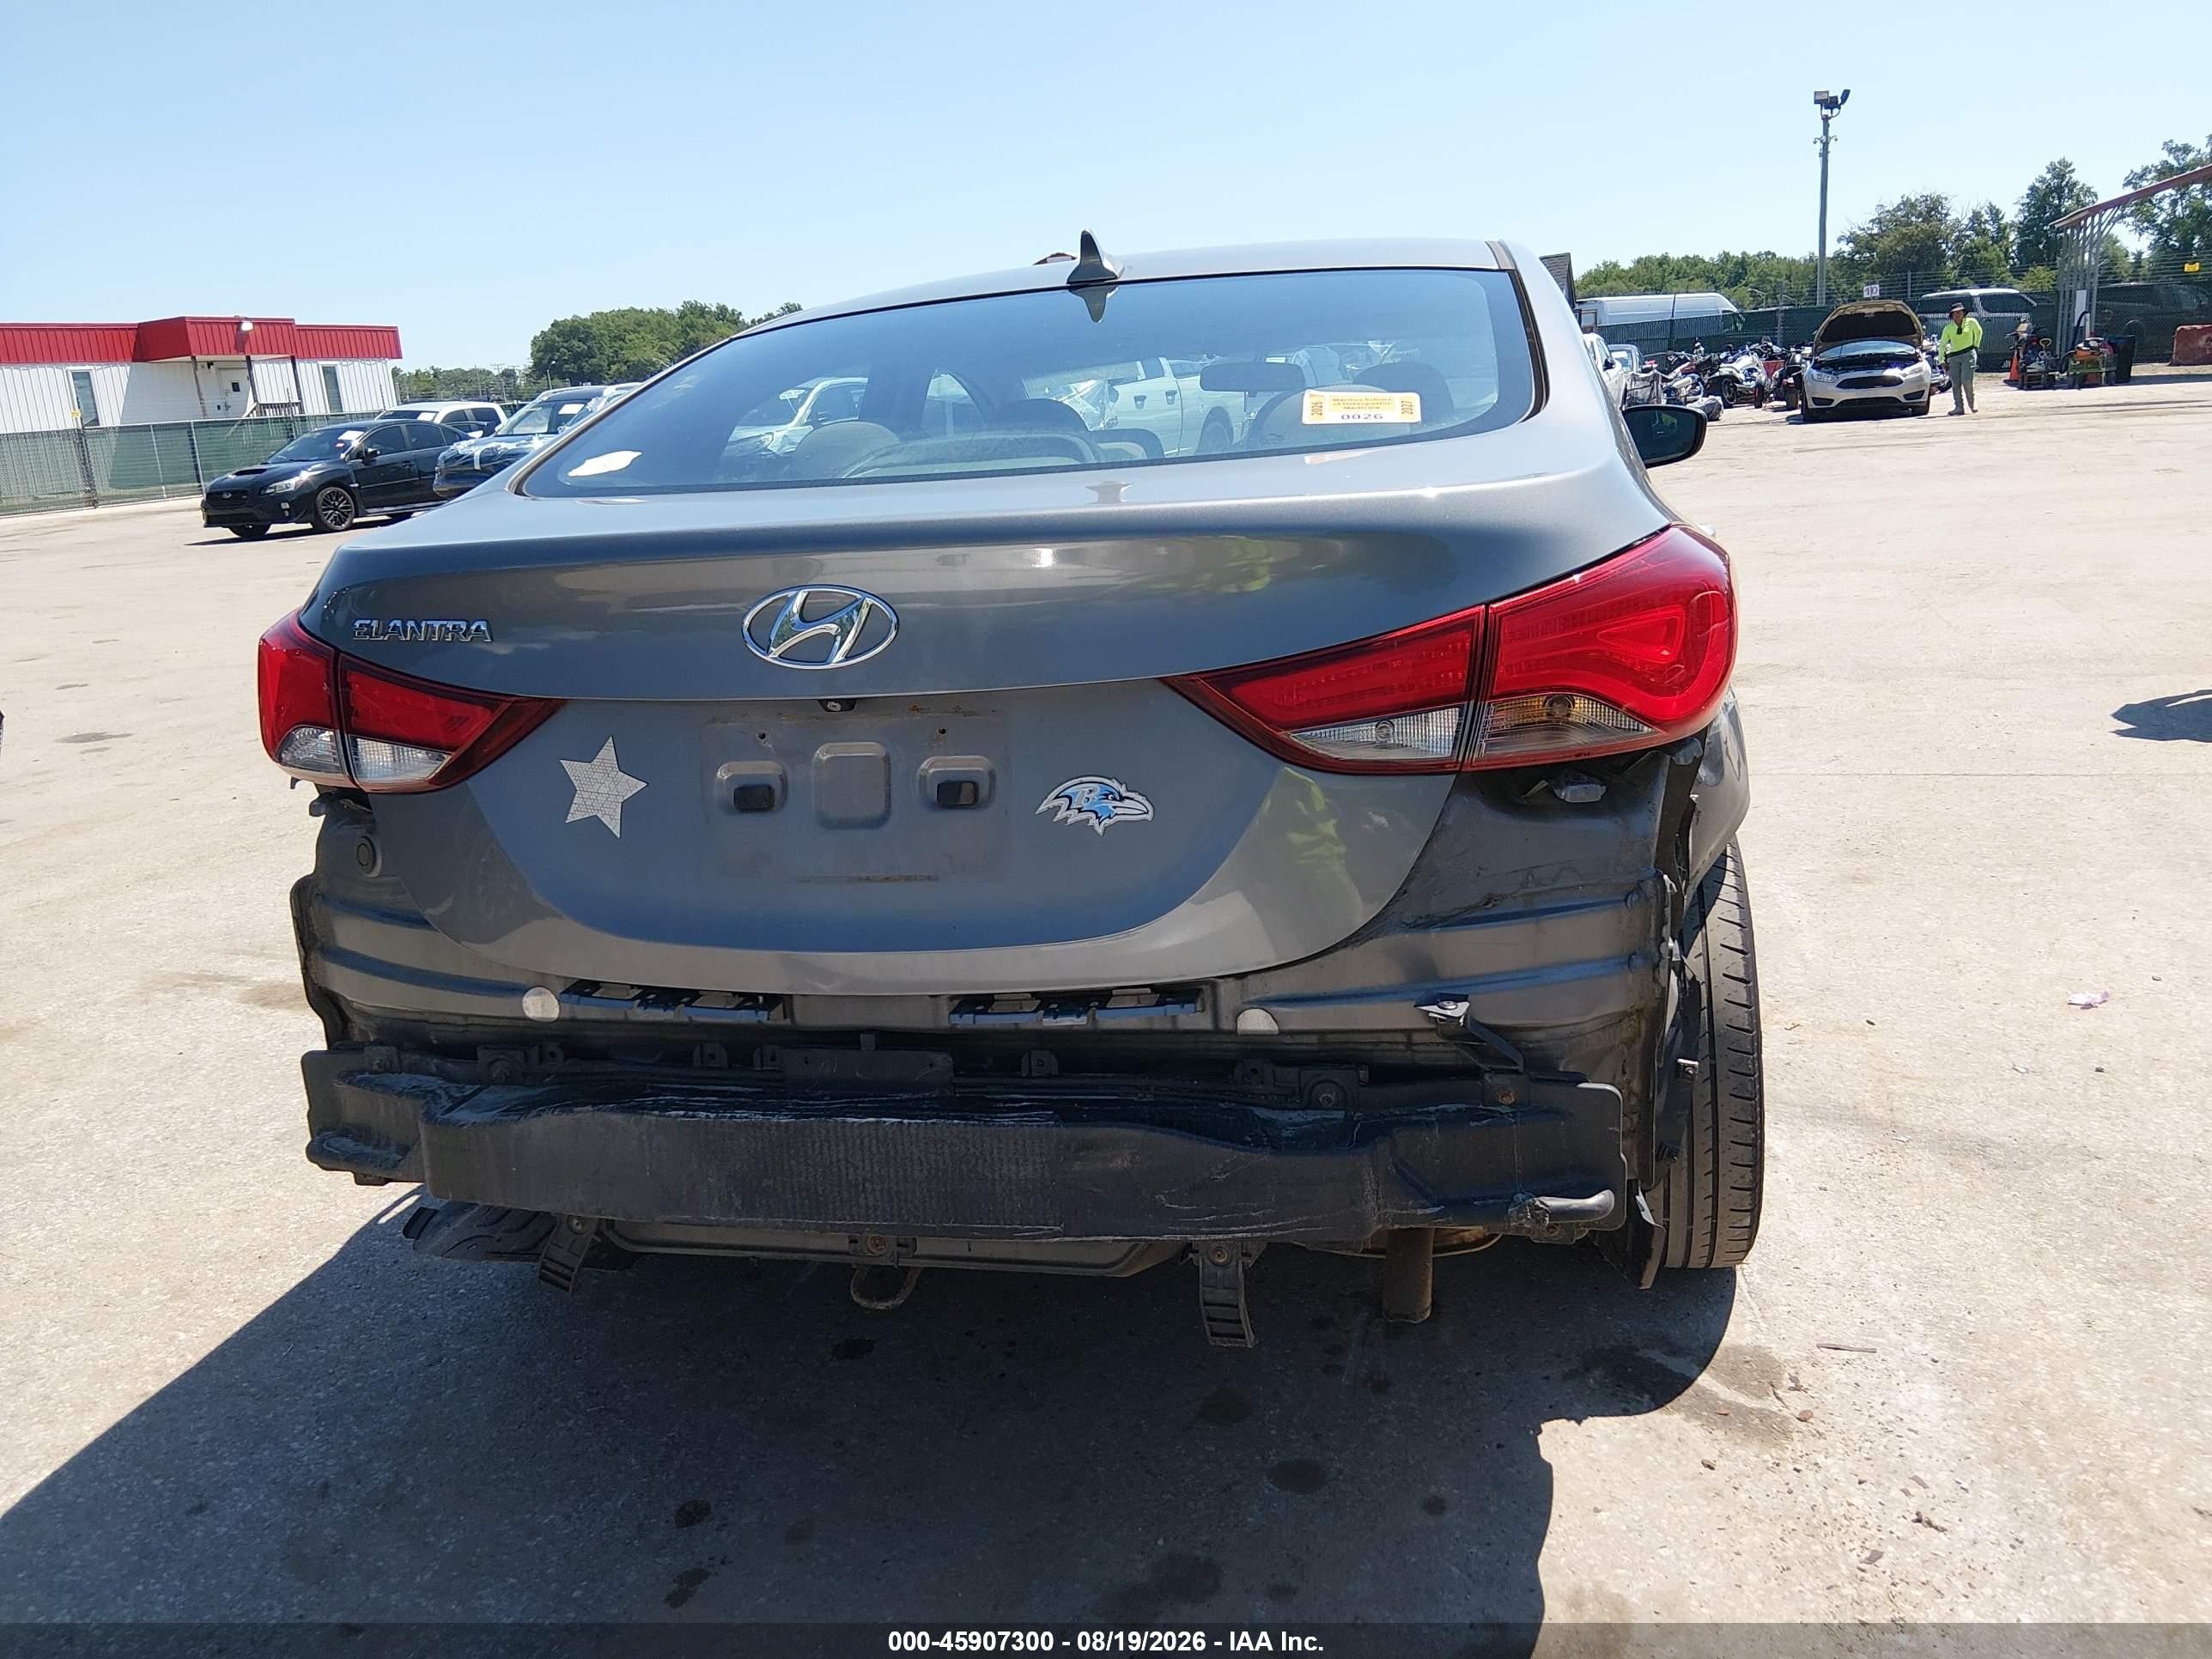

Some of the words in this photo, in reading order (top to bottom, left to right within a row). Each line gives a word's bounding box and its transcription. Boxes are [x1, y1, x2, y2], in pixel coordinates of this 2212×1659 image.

[1310, 401, 1323, 416] 2026
[1401, 400, 1413, 415] 2027
[352, 618, 493, 642] ELANTRA
